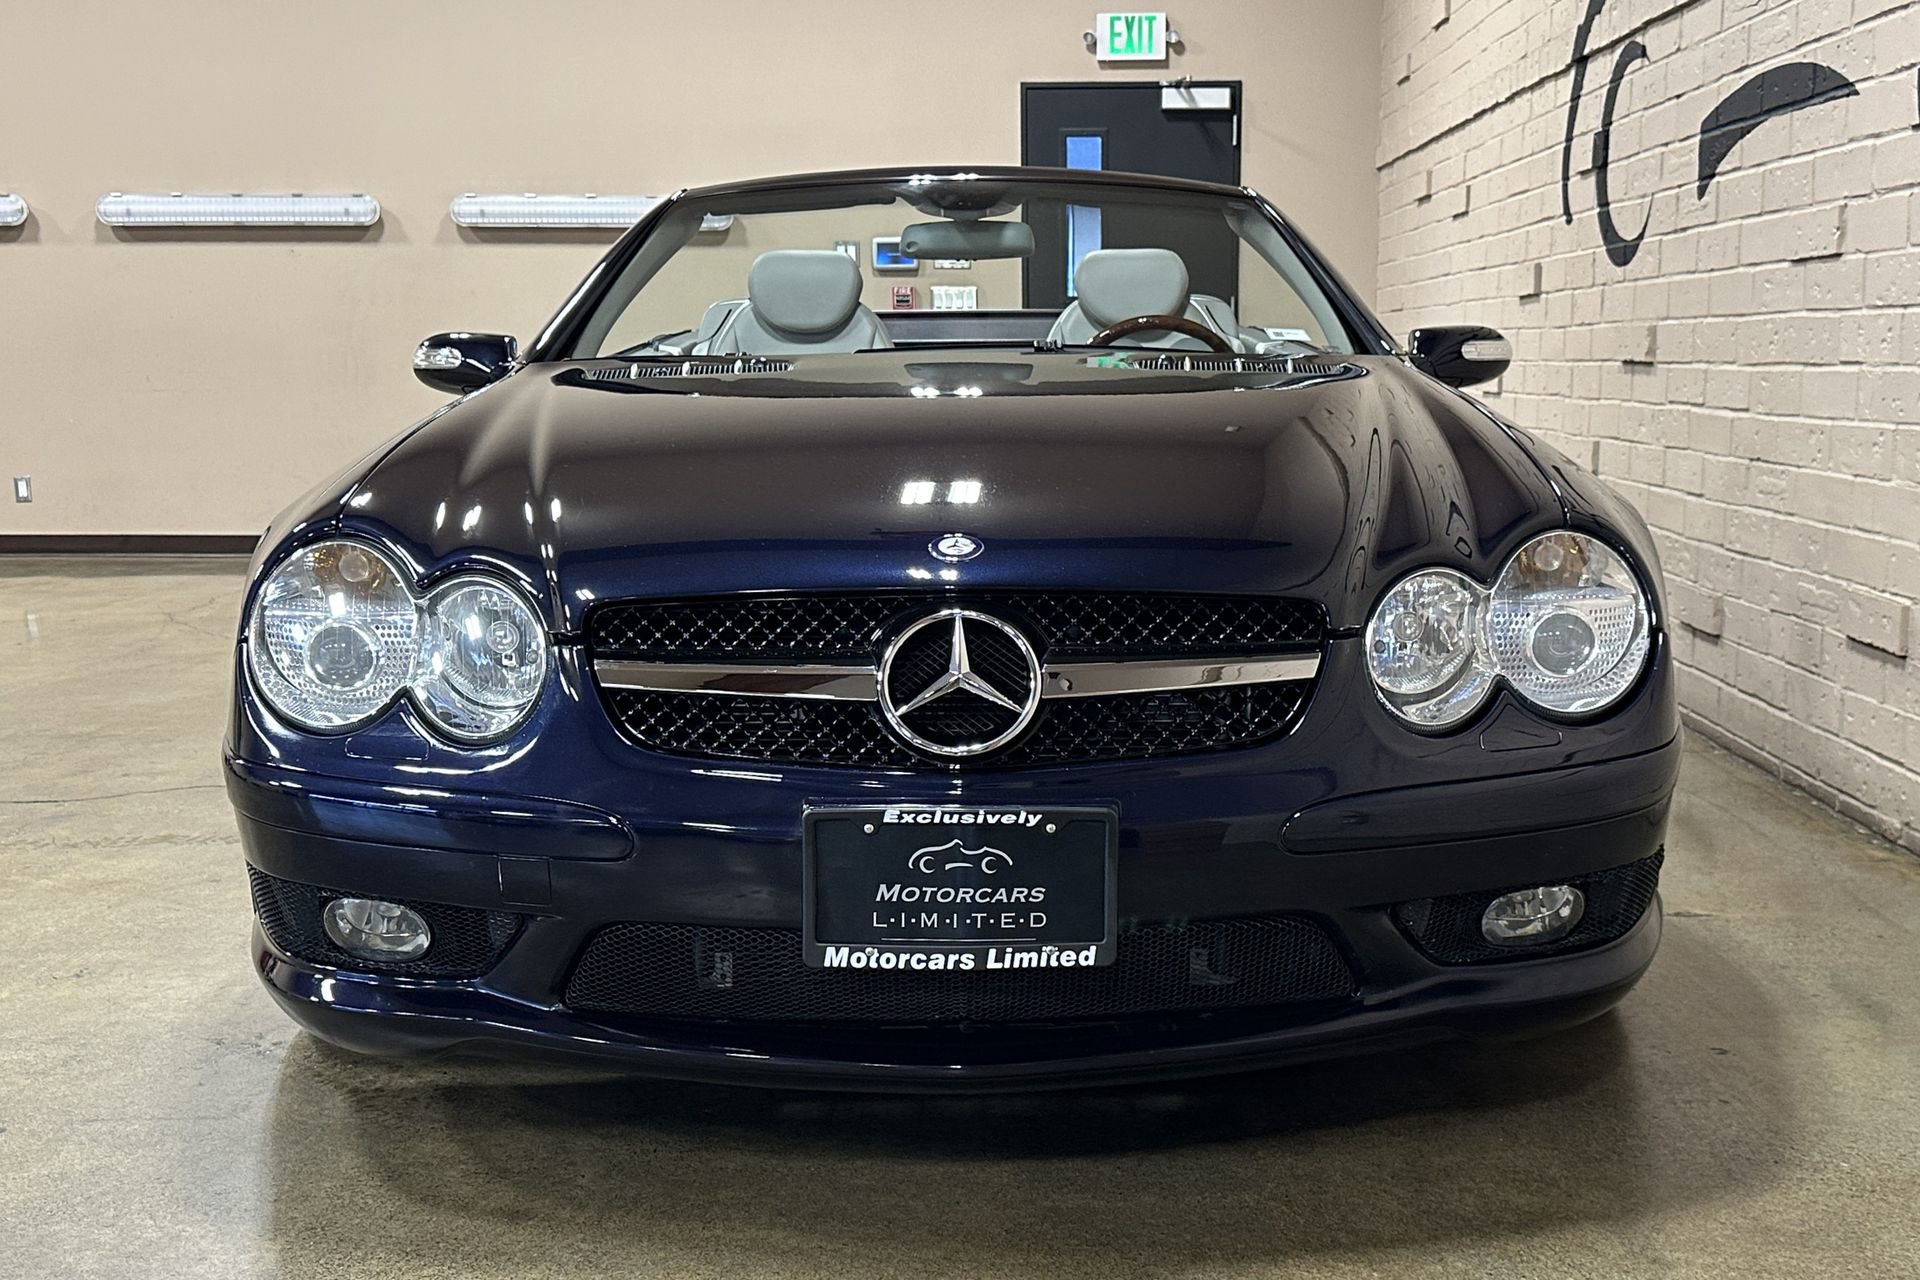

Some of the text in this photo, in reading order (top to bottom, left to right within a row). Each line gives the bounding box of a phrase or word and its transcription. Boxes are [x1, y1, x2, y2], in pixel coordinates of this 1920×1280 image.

[1109, 15, 1157, 55] EXIT
[883, 810, 1043, 827] Exclusively
[875, 883, 1047, 903] MOTORCARS
[823, 945, 1097, 970] Motorcars Limited
